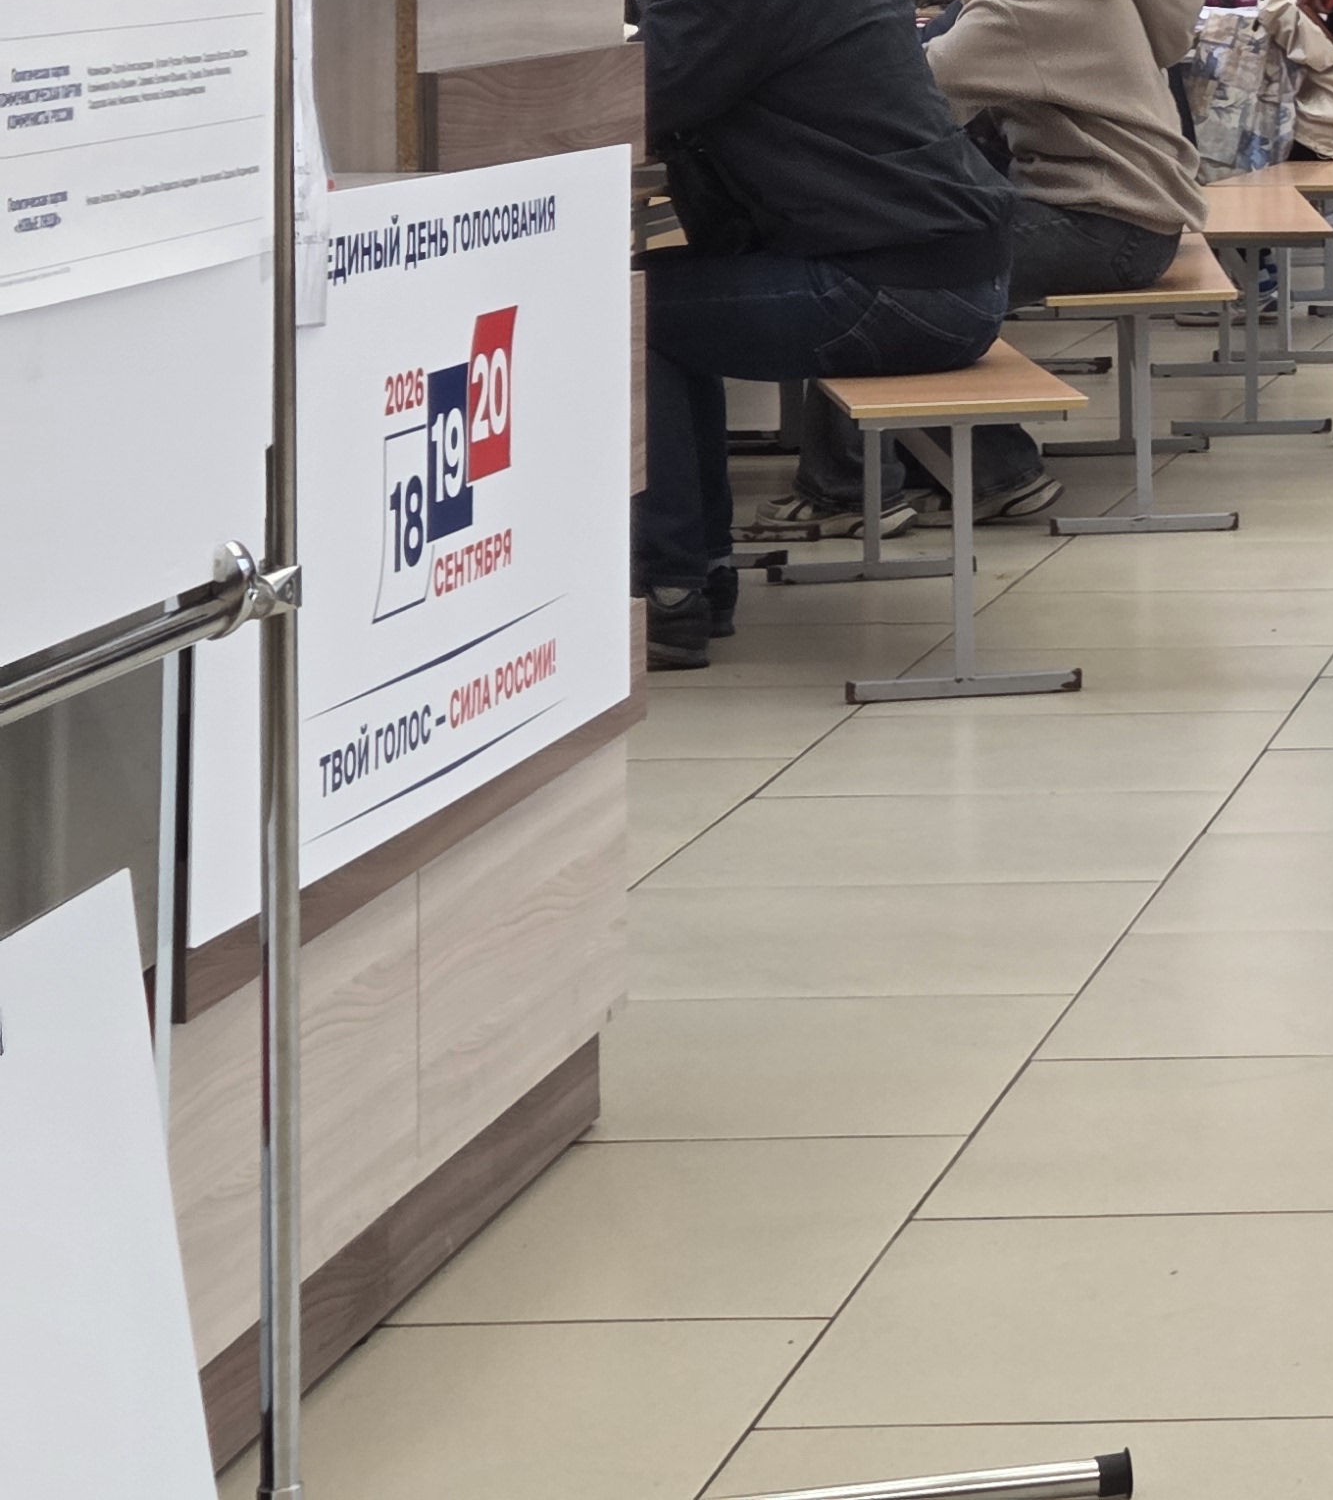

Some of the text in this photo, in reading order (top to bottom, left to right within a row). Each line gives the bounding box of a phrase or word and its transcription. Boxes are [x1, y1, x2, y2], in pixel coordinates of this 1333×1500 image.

[404, 217, 449, 271] ДЕНЬ
[452, 194, 556, 254] ГОЛОСОВАНИЯ
[384, 366, 425, 416] 2026
[389, 347, 508, 574] 18 19 20
[434, 528, 513, 598] СЕНТЯБРЯ
[319, 723, 370, 798] ТВОЙ
[374, 703, 432, 770] ГОЛОС
[449, 674, 491, 730] СИЛА
[495, 637, 557, 705] РОССИИ!
